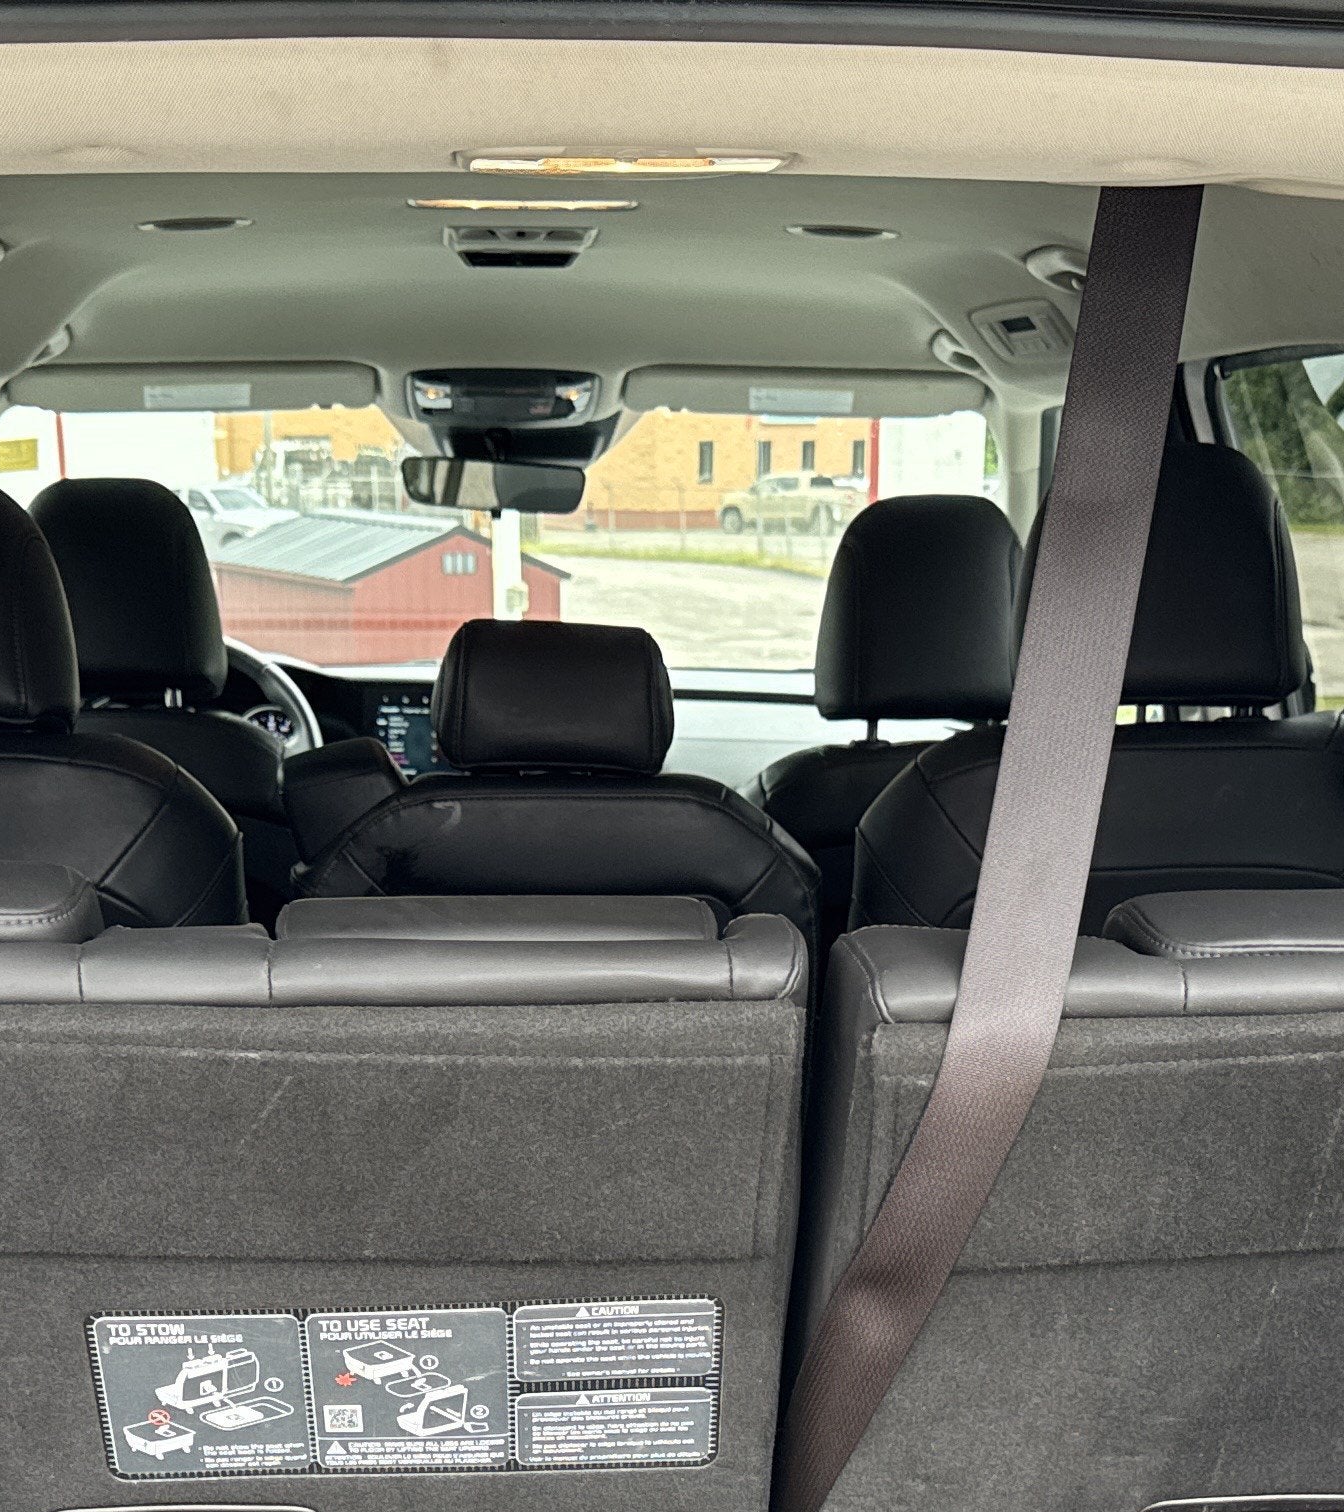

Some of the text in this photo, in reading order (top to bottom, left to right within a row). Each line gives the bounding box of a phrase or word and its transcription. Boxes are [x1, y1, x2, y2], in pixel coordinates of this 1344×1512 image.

[592, 1306, 639, 1316] CAUTION
[107, 1323, 185, 1336] TO STOW
[318, 1318, 430, 1332] TO USE SEAT
[592, 1393, 650, 1403] ATTENTION
